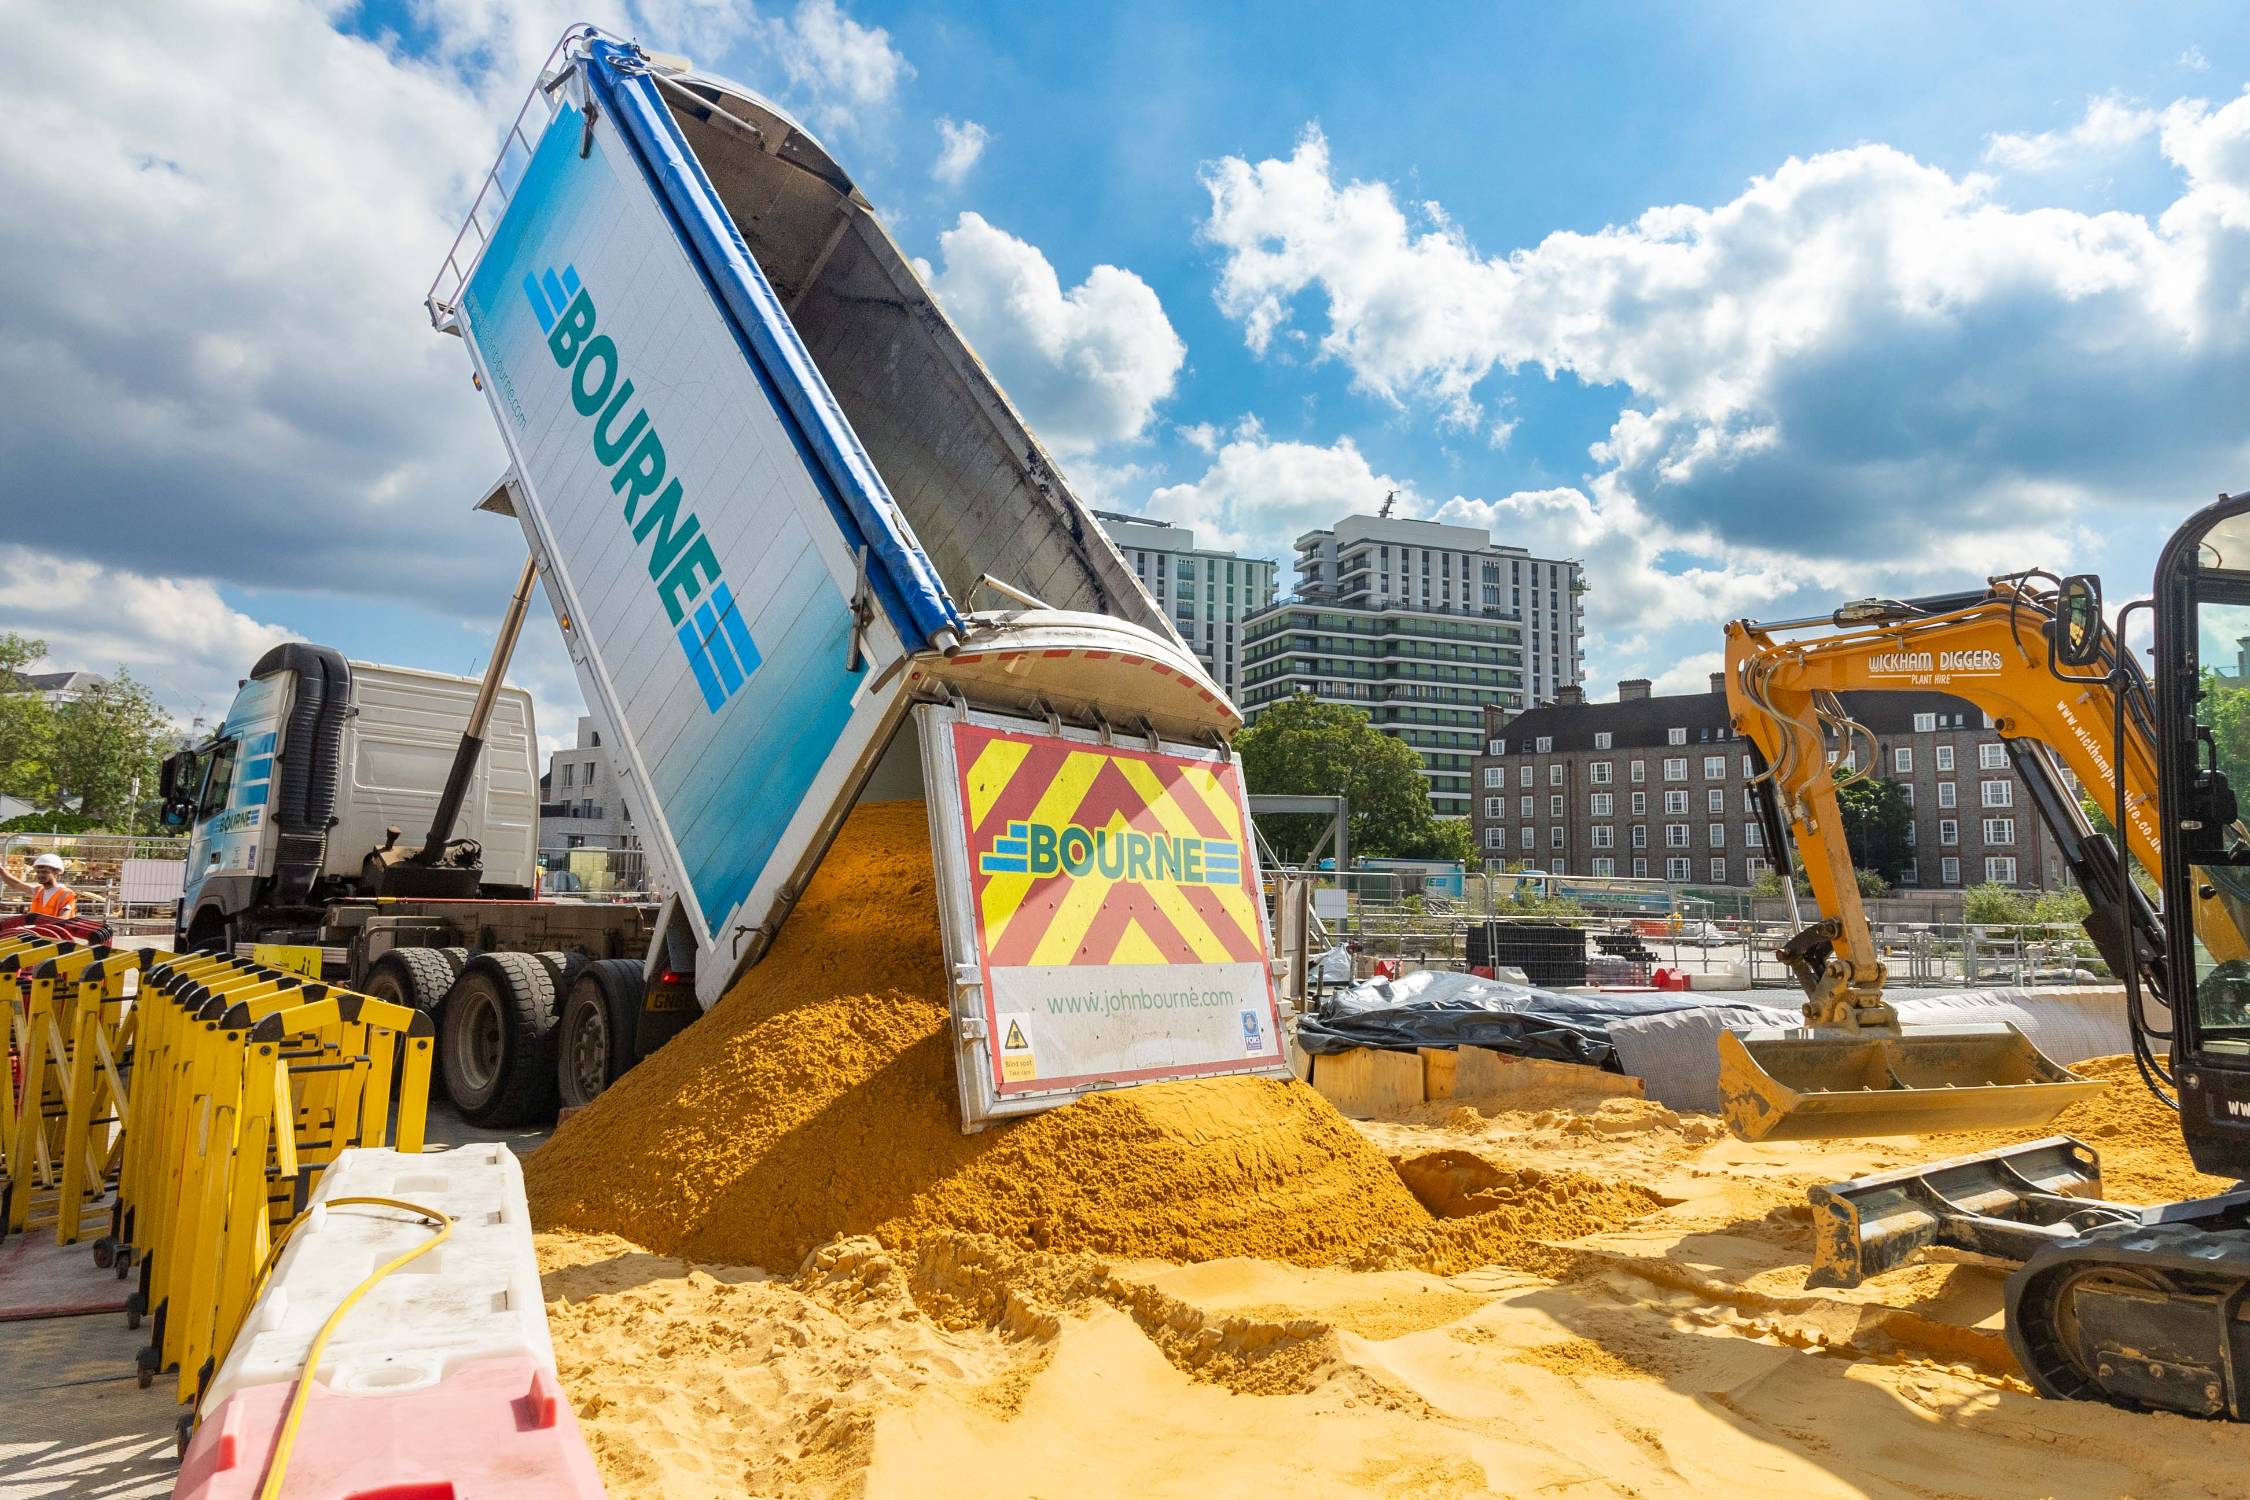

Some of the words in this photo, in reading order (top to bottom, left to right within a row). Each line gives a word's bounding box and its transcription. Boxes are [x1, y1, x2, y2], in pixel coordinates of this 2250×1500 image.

[548, 286, 722, 628] BOURNE
[1868, 652, 1934, 672] WICKHAM
[1939, 650, 2002, 671] DIGGERS
[1911, 674, 1932, 685] PLANT
[1934, 673, 1950, 684] HIRE
[2056, 700, 2162, 854] www.wickhamplahire.co.uk
[219, 809, 251, 832] BOURNE
[1030, 823, 1203, 883] BOURNE
[1046, 988, 1234, 1018] www.johnbourne.com
